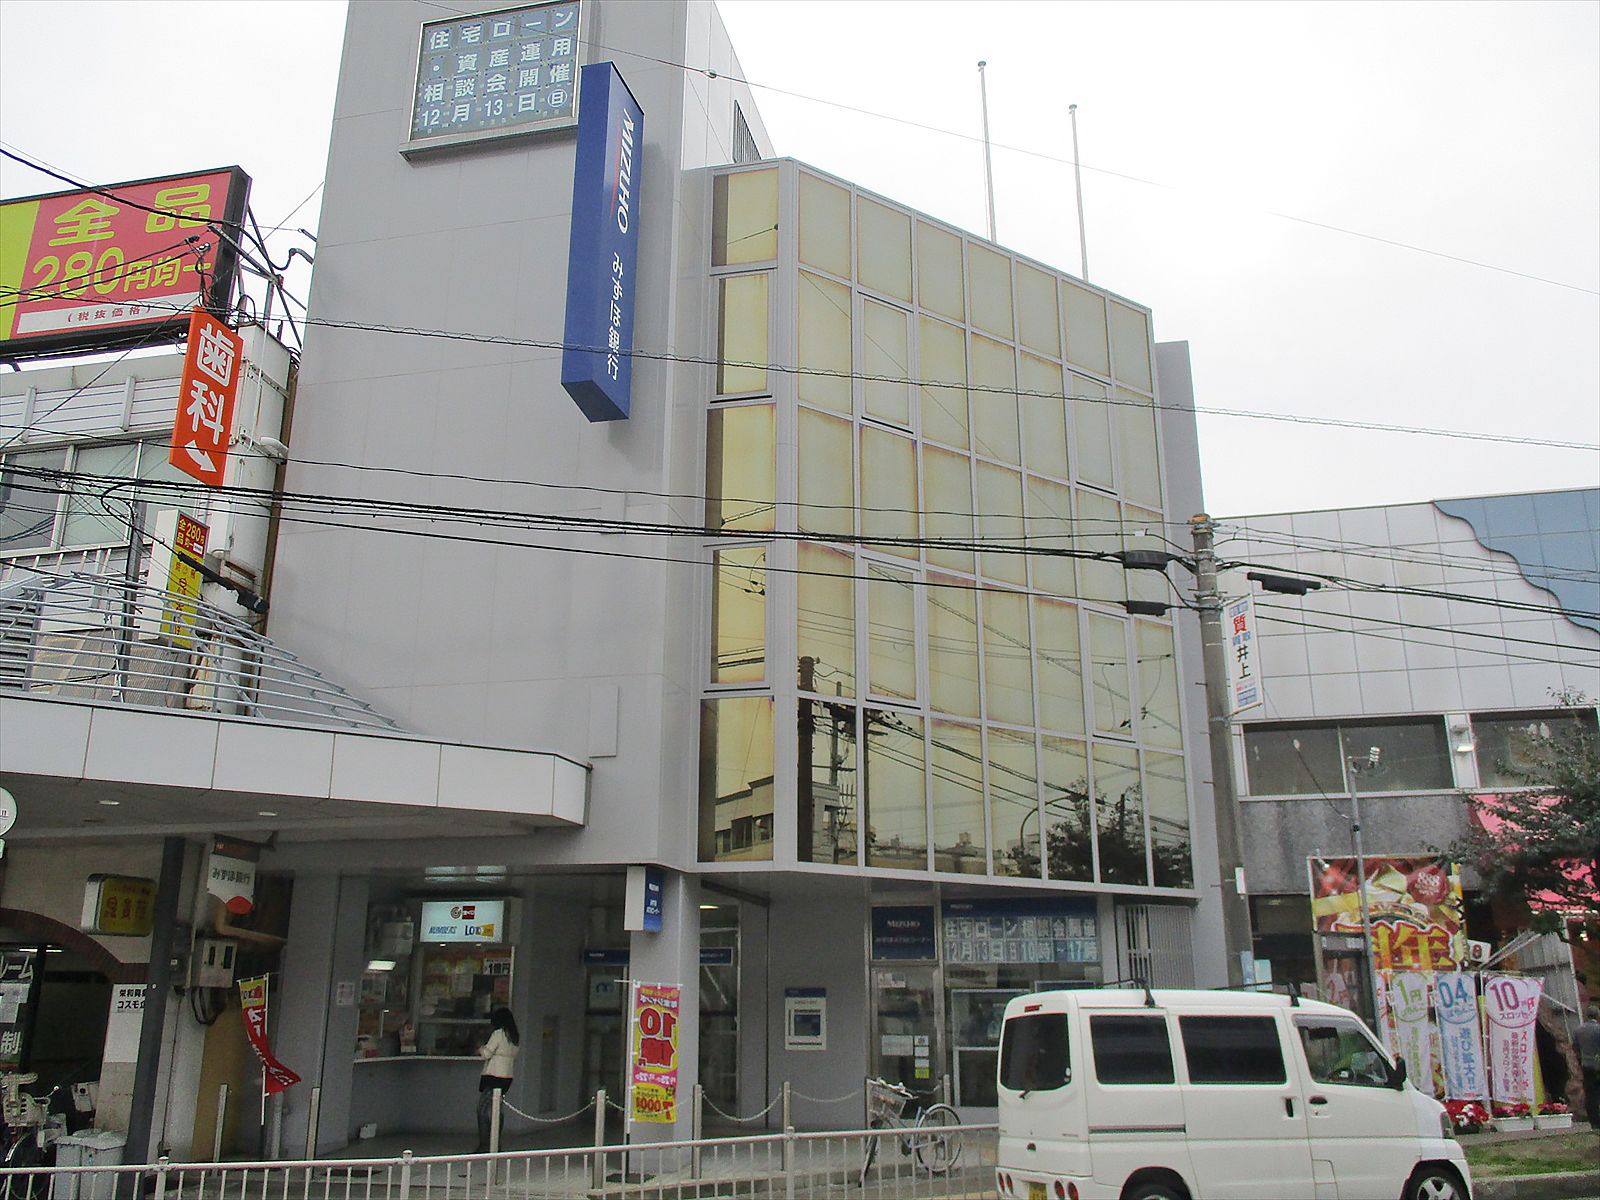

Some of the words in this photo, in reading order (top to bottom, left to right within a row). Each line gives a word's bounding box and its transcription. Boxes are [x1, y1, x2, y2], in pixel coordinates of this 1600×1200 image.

[430, 10, 574, 50] 住宅ローン
[424, 63, 571, 103] 相談会開催
[616, 108, 636, 235] MIZUHO
[48, 183, 211, 247] 全品
[27, 246, 213, 300] 280円均一
[607, 251, 625, 382] みずほ銀行
[186, 322, 235, 446] 歯科
[1233, 613, 1248, 635] 質
[1237, 643, 1251, 680] 井上
